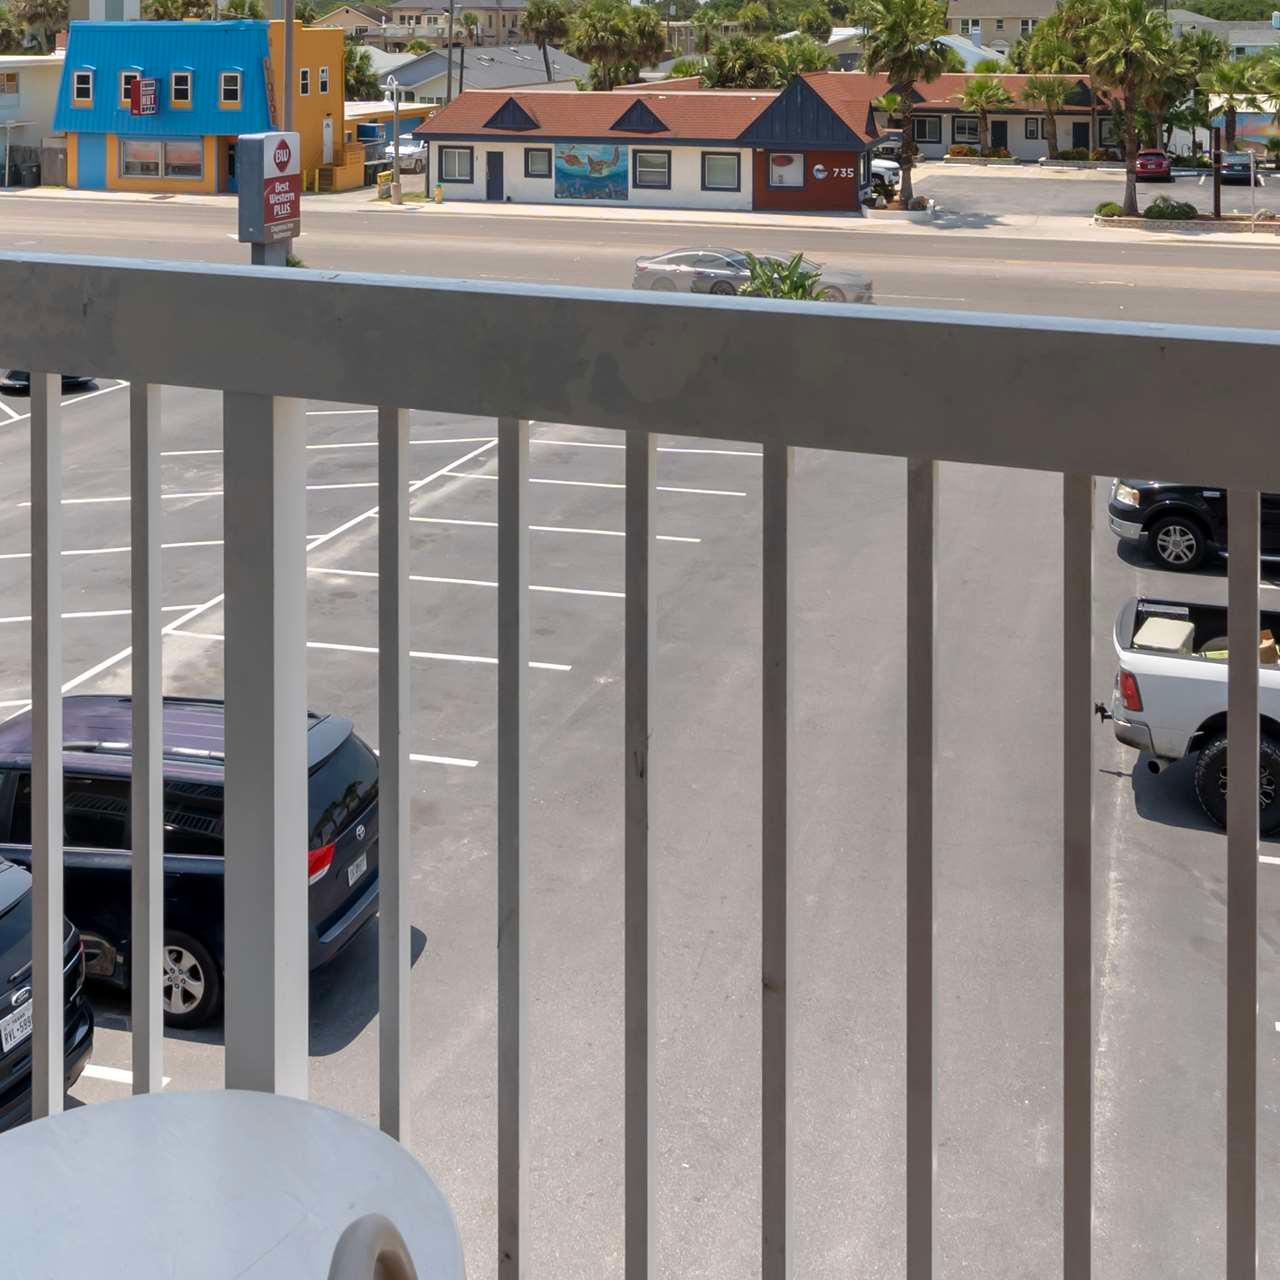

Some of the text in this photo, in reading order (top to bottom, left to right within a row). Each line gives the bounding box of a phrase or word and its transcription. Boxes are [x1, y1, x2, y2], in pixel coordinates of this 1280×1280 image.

[275, 148, 289, 163] BW
[832, 167, 854, 178] 735
[275, 181, 289, 192] Best
[269, 192, 295, 204] Western
[273, 202, 290, 216] PLUS
